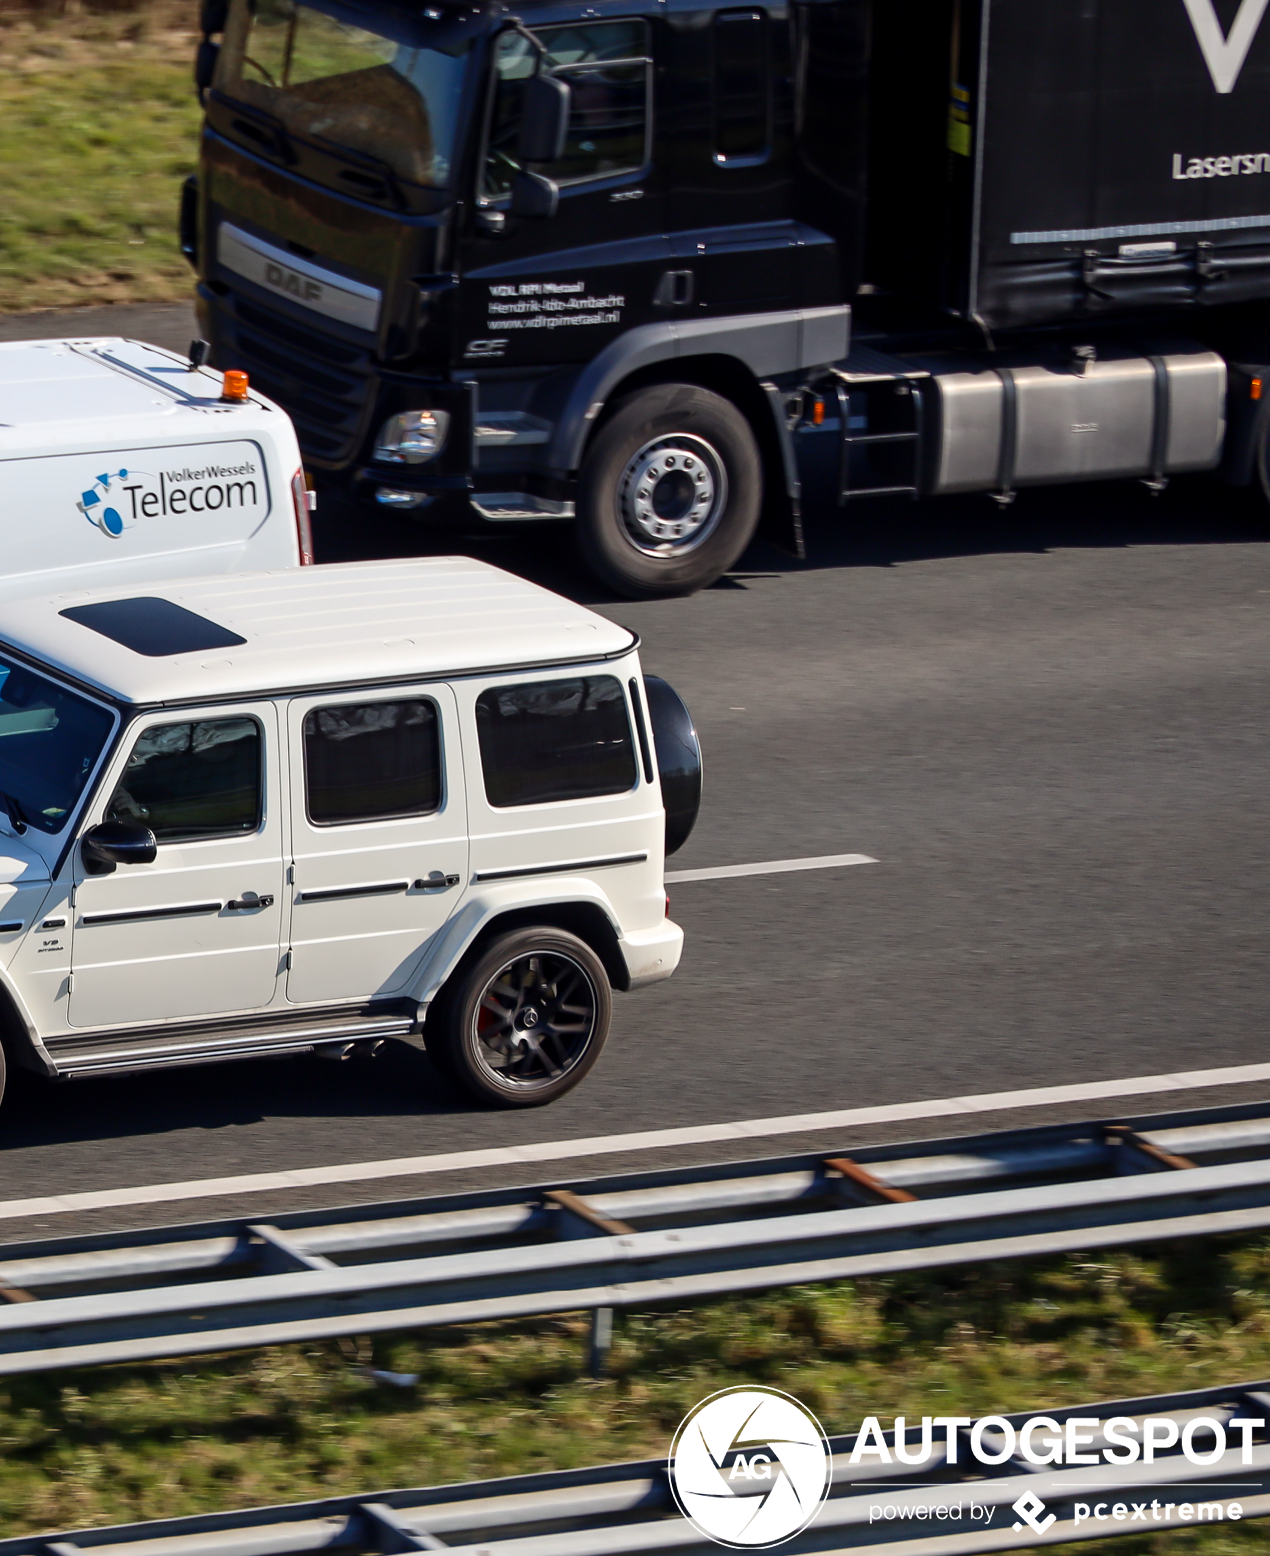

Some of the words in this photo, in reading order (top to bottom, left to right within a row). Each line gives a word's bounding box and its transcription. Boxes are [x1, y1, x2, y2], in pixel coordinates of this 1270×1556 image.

[265, 262, 323, 301] DAF
[467, 339, 510, 352] CF
[166, 461, 256, 484] VolkerWessels
[122, 471, 258, 520] Telecom
